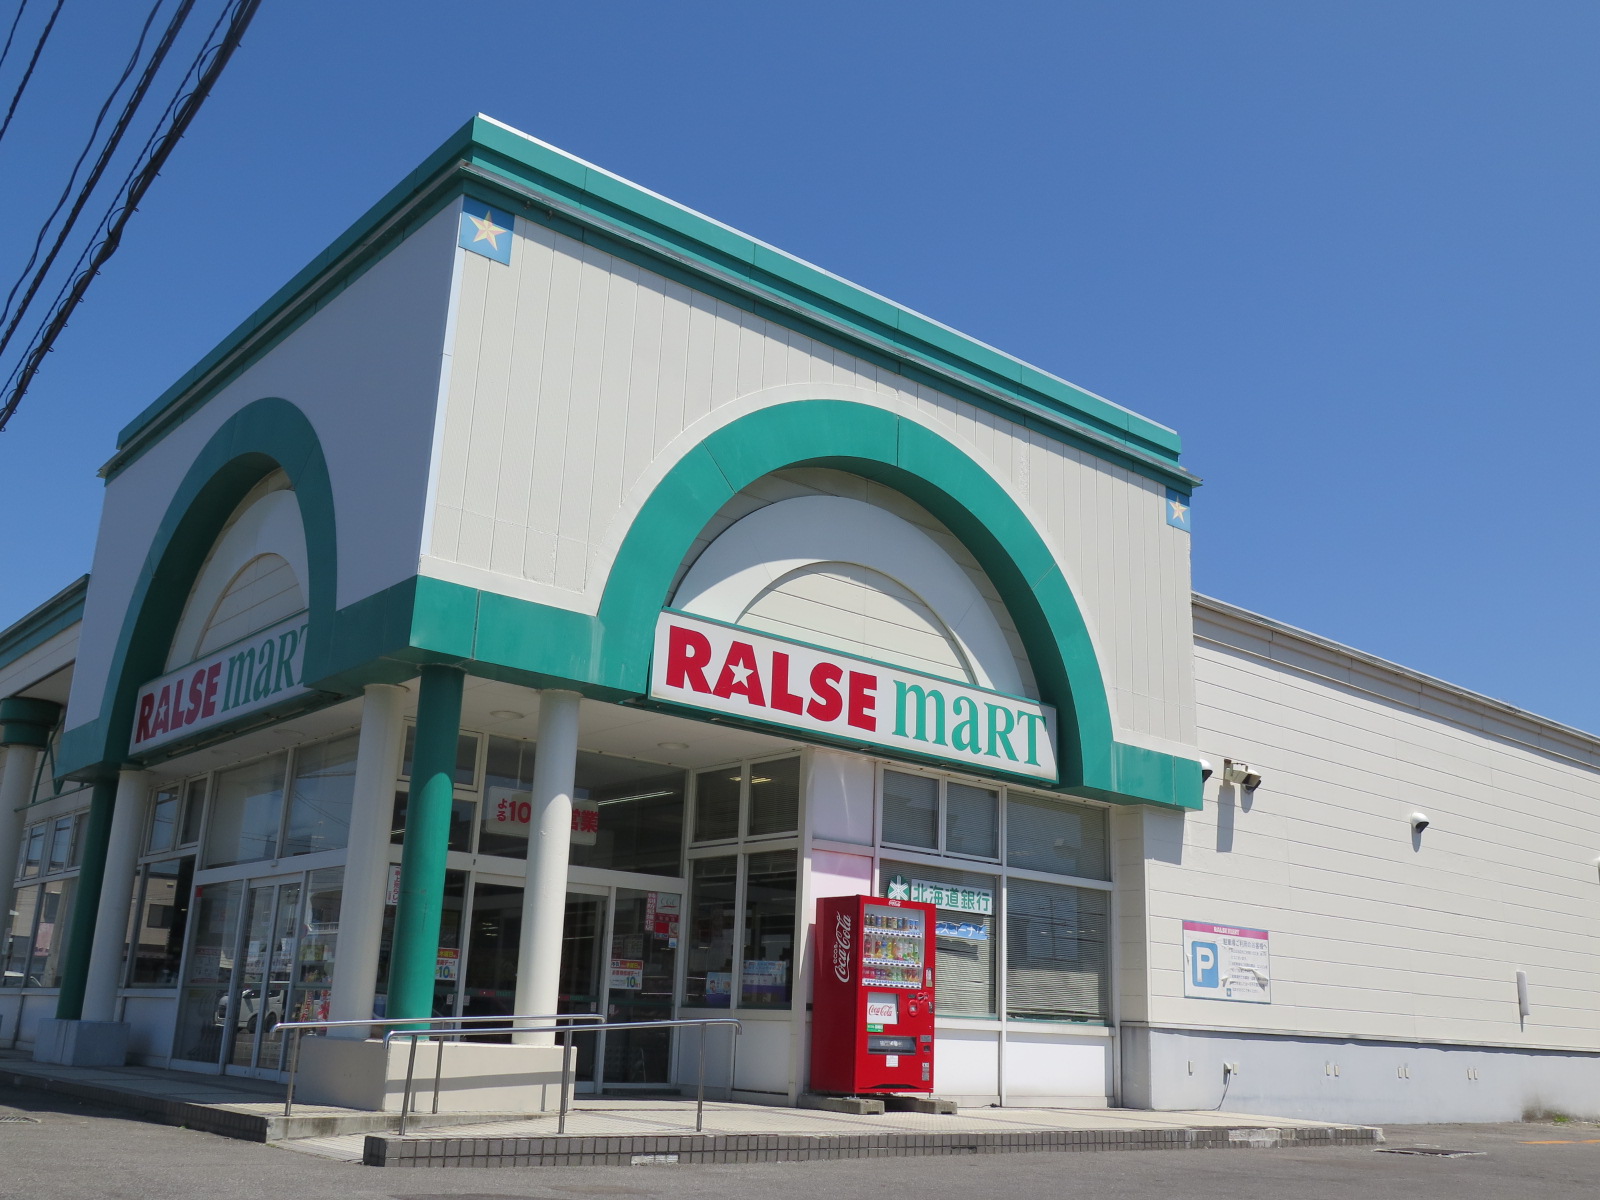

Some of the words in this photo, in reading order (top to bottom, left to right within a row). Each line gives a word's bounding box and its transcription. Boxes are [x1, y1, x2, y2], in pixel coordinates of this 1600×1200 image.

[135, 661, 223, 744] RALSE
[665, 624, 878, 733] RALSE
[913, 883, 990, 912] 北海道銀行
[1197, 947, 1214, 982] P
